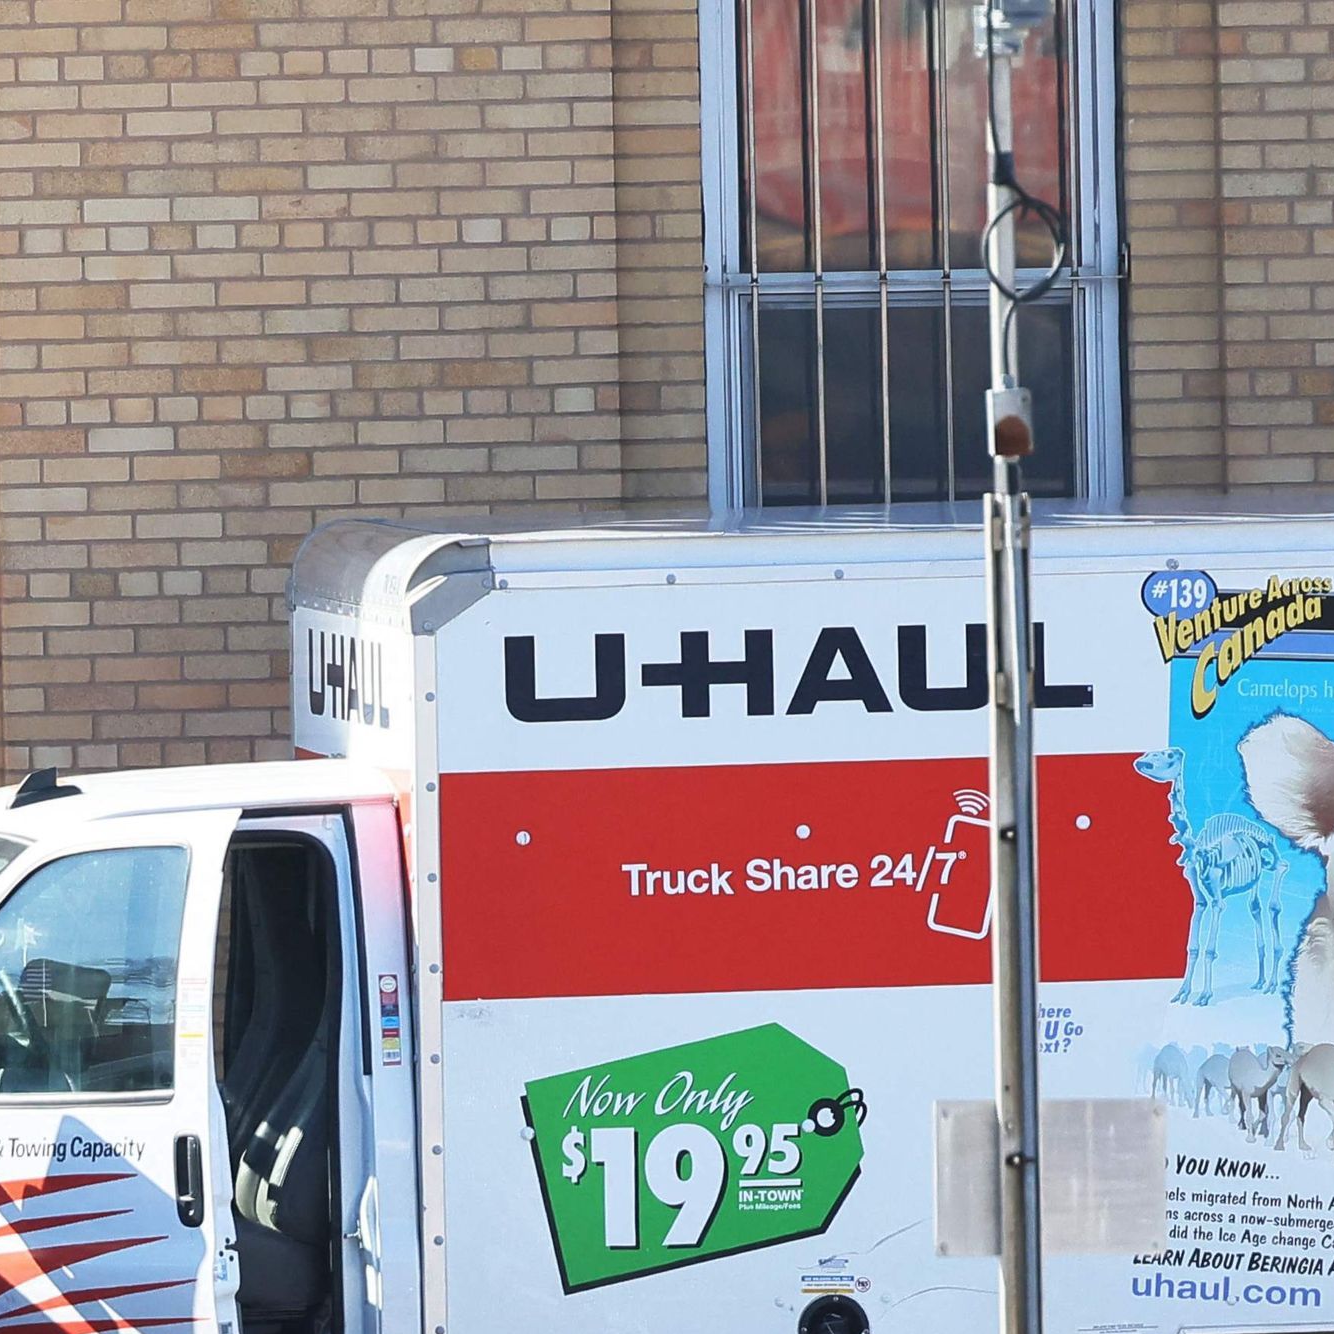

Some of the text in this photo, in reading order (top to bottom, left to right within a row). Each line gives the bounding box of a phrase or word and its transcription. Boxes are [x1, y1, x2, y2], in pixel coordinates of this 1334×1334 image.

[1151, 578, 1208, 609] #139
[1154, 575, 1333, 662] Venture Across
[1191, 596, 1323, 717] Canada
[308, 628, 390, 729] U-HAUL
[504, 622, 1094, 723] U-HAUL
[1237, 678, 1317, 704] Camelops
[621, 862, 735, 896] Truck
[745, 857, 859, 892] Share
[1044, 1020, 1084, 1040] U Go
[563, 1071, 755, 1132] Now Only
[8, 1137, 66, 1163] Towing
[70, 1136, 146, 1162] Capacity
[1176, 1154, 1209, 1176] YOU
[1214, 1157, 1280, 1180] KNOW...
[1192, 1190, 1246, 1207] migrated
[1251, 1192, 1281, 1208] from
[1287, 1194, 1323, 1211] North
[1184, 1211, 1224, 1223] across
[1228, 1213, 1236, 1224] a
[1168, 1225, 1188, 1240] did
[1193, 1225, 1213, 1241] the
[1219, 1228, 1236, 1242] Ice
[1241, 1229, 1267, 1247] Age
[1271, 1231, 1316, 1250] change
[1187, 1248, 1245, 1270] ABOUT
[1247, 1252, 1324, 1276] BERINGIA
[1132, 1273, 1322, 1307] uhaul.com
